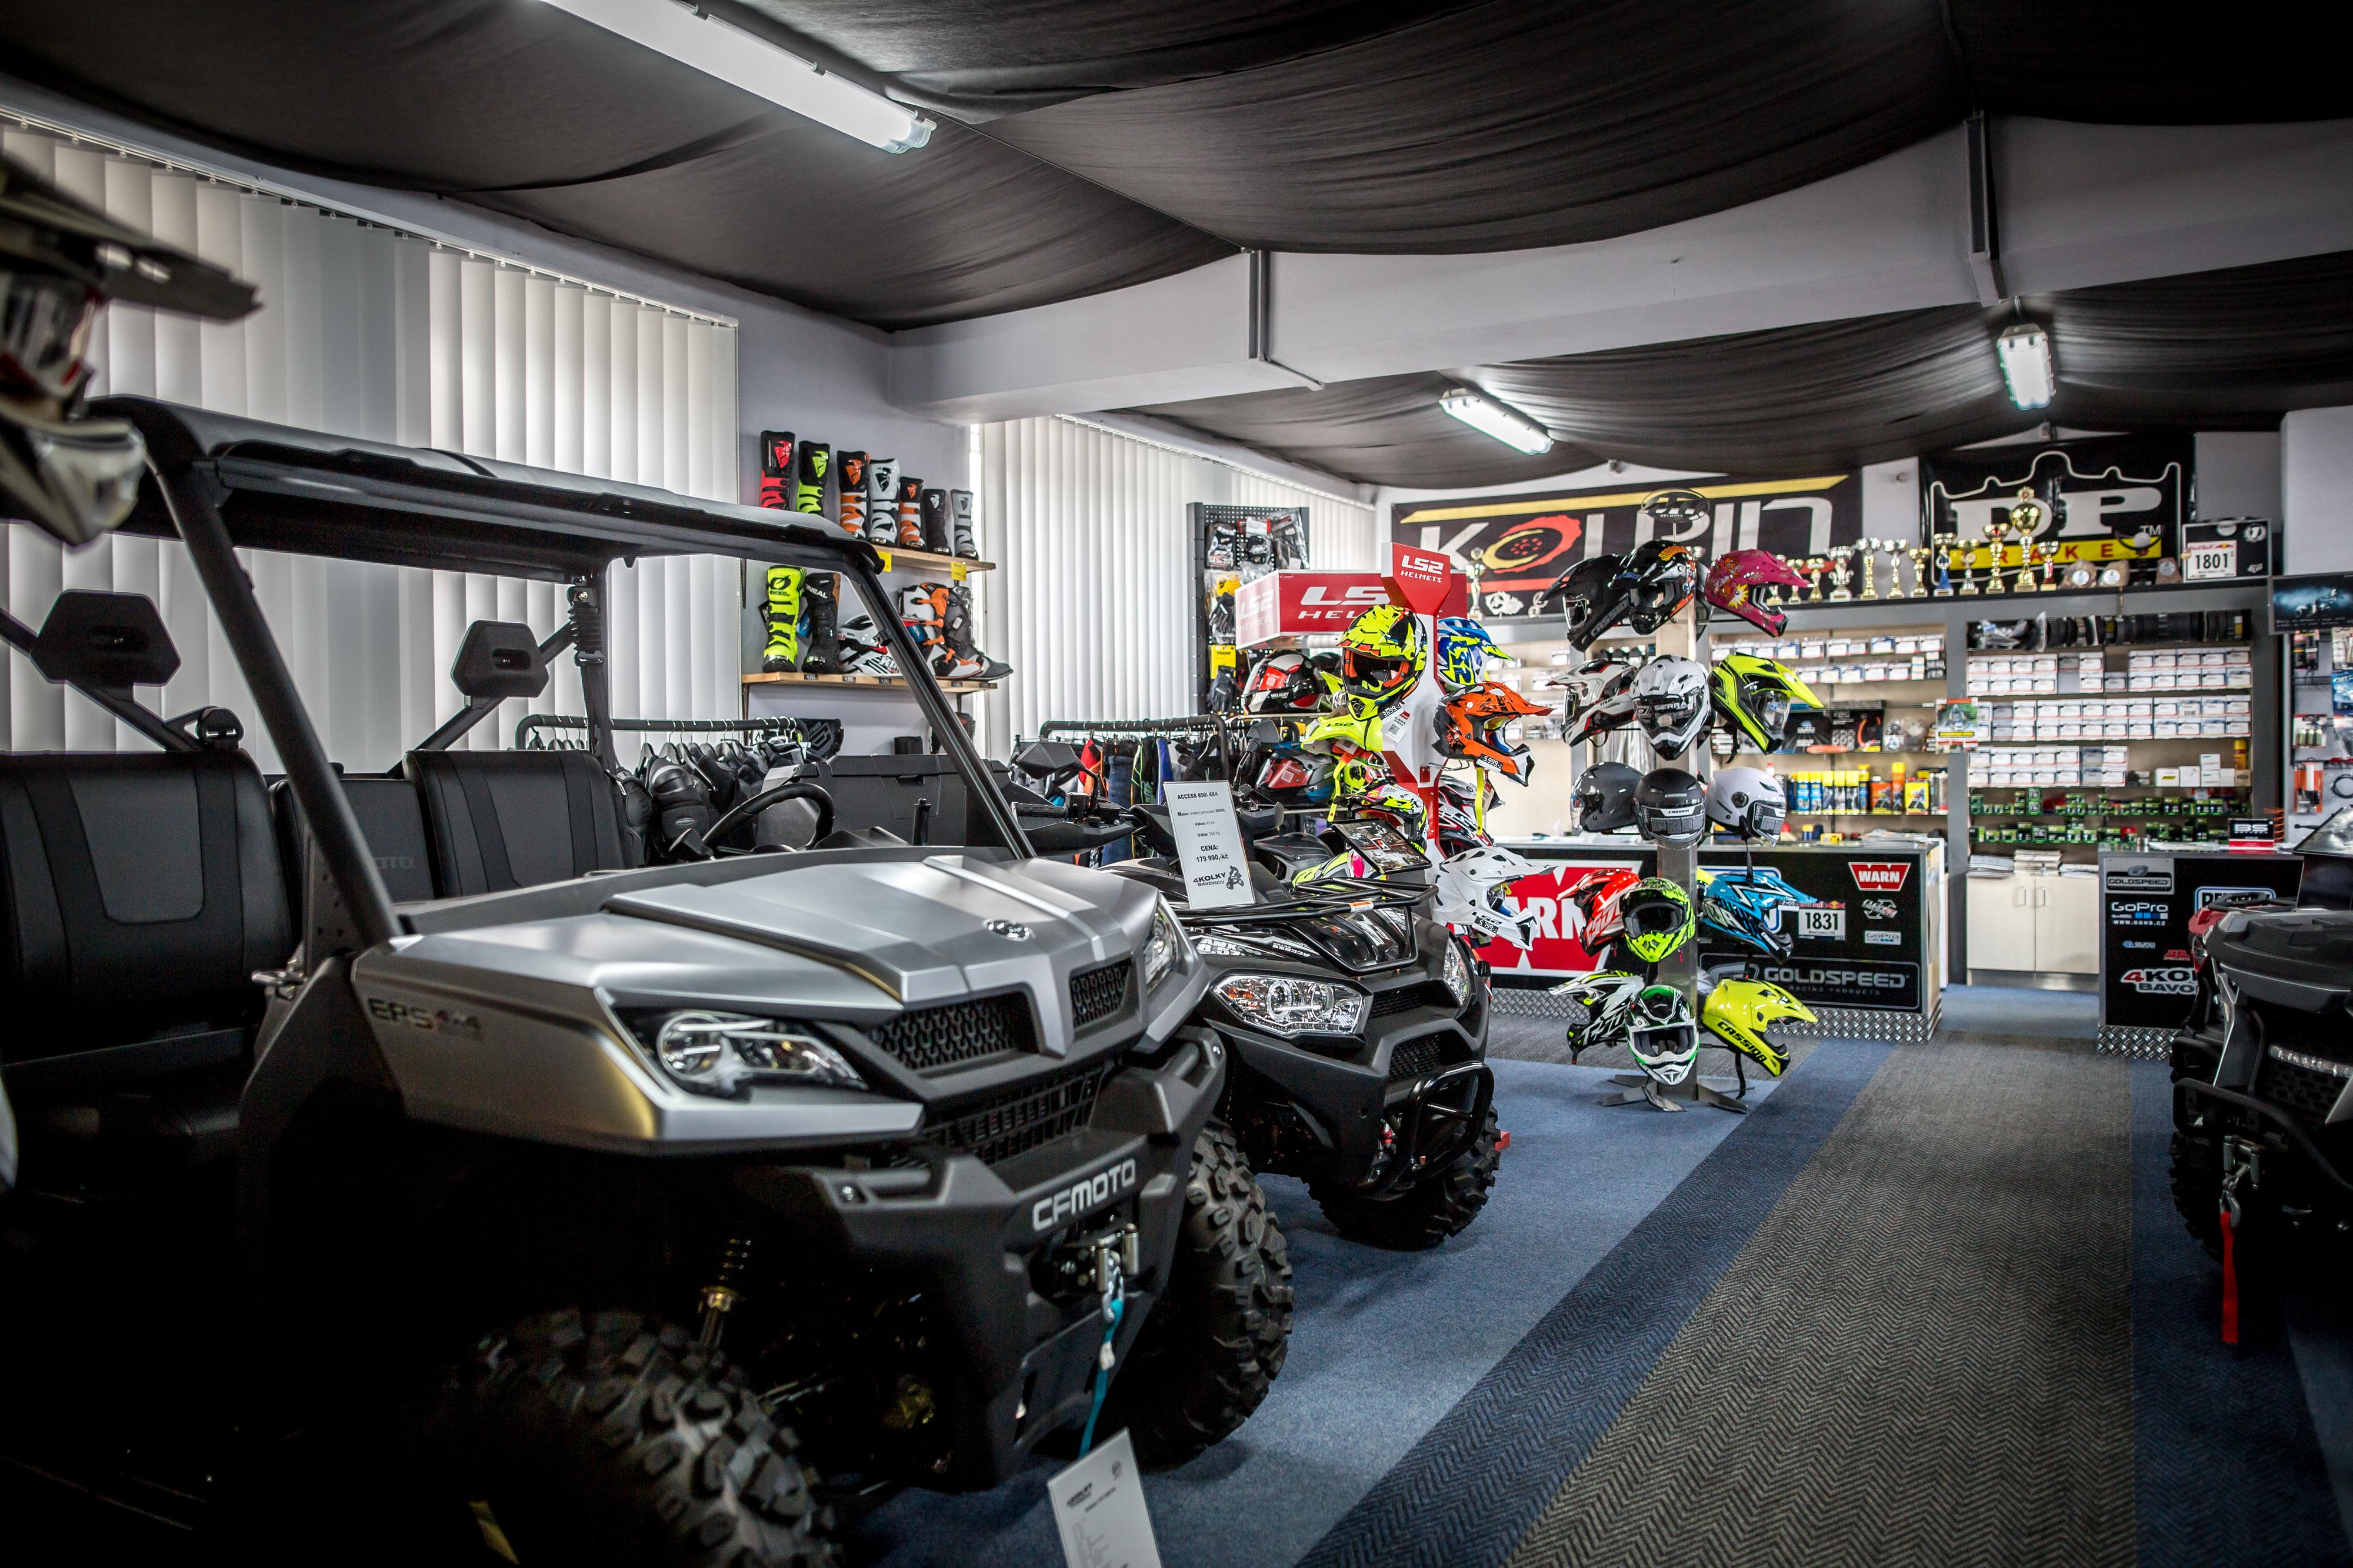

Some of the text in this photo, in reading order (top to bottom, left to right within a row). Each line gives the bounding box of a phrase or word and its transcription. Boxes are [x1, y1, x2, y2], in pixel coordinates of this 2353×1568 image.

[1951, 487, 2162, 545] DP
[2139, 525, 2162, 535] TM
[1401, 555, 1444, 575] LS2
[2195, 553, 2228, 569] 1801
[1400, 571, 1442, 583] HELMETS
[1239, 588, 1274, 619] LS2
[1301, 586, 1392, 605] LS
[1590, 601, 1627, 637] CASSID
[1654, 701, 1688, 710] SIERRA
[1193, 872, 1226, 883] 4KOLKY
[1858, 870, 1900, 883] WARN
[2111, 902, 2168, 912] GoPro
[1471, 912, 1502, 925] LS2
[1805, 912, 1838, 930] 1831
[1764, 967, 1906, 989] GOLDSPEED
[2124, 970, 2198, 982] 4KO
[2139, 983, 2198, 993] BAVO
[369, 999, 434, 1030] EPS
[1718, 1021, 1768, 1063] CASSIDA
[1033, 1159, 1136, 1232] CFMOTO
